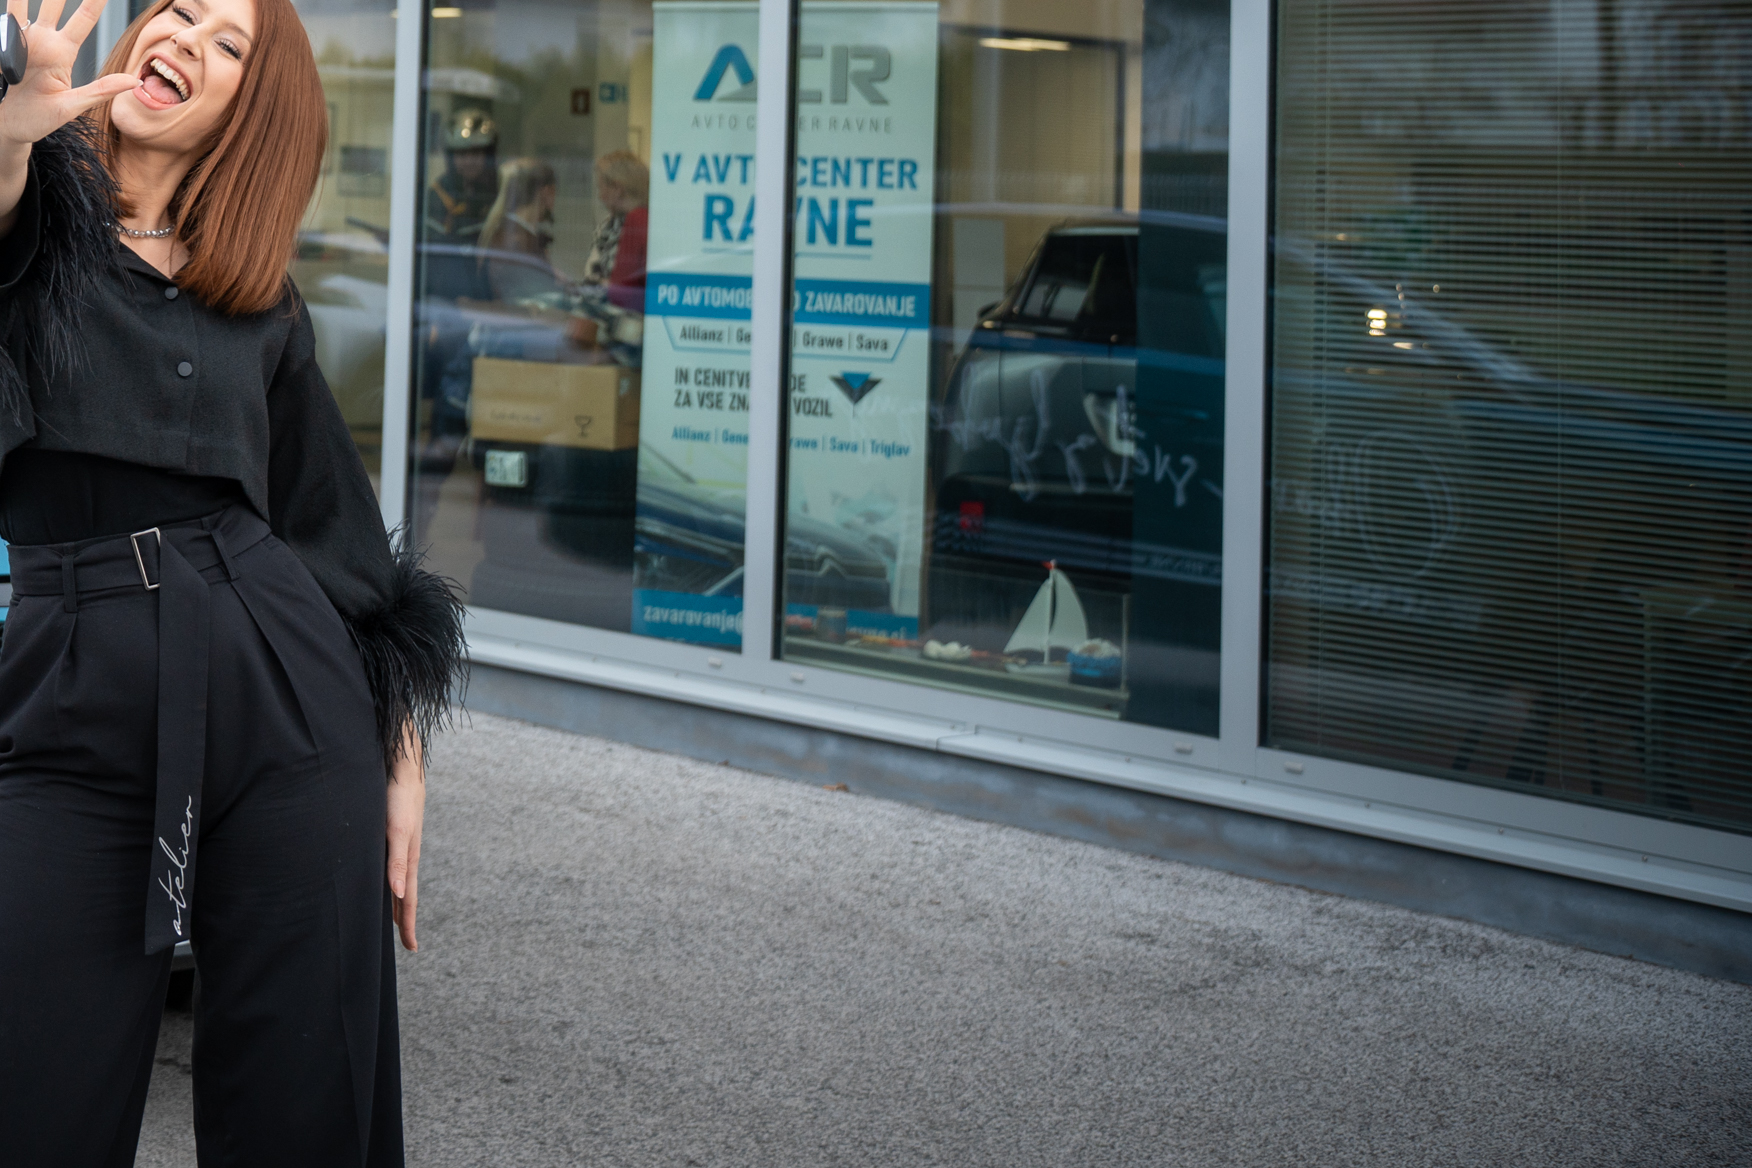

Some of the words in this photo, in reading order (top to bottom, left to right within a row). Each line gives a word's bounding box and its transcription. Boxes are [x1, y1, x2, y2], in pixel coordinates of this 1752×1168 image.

[691, 115, 738, 131] AVTO
[746, 116, 820, 133] CER
[828, 117, 892, 134] RAVNE
[662, 152, 682, 185] V
[692, 153, 754, 186] AVT
[795, 156, 919, 191] CENTER
[702, 193, 874, 248] RANE
[657, 284, 679, 306] PO
[804, 290, 916, 318] ZAVAROVANJE
[679, 324, 724, 344] Allianz
[802, 331, 844, 350] Grawe
[856, 335, 888, 352] Sava
[674, 367, 689, 386] IN
[673, 389, 692, 408] ZA
[697, 390, 721, 410] VSE
[792, 397, 834, 417] VOZIL
[829, 435, 858, 453] Sava
[870, 439, 910, 459] Triglav
